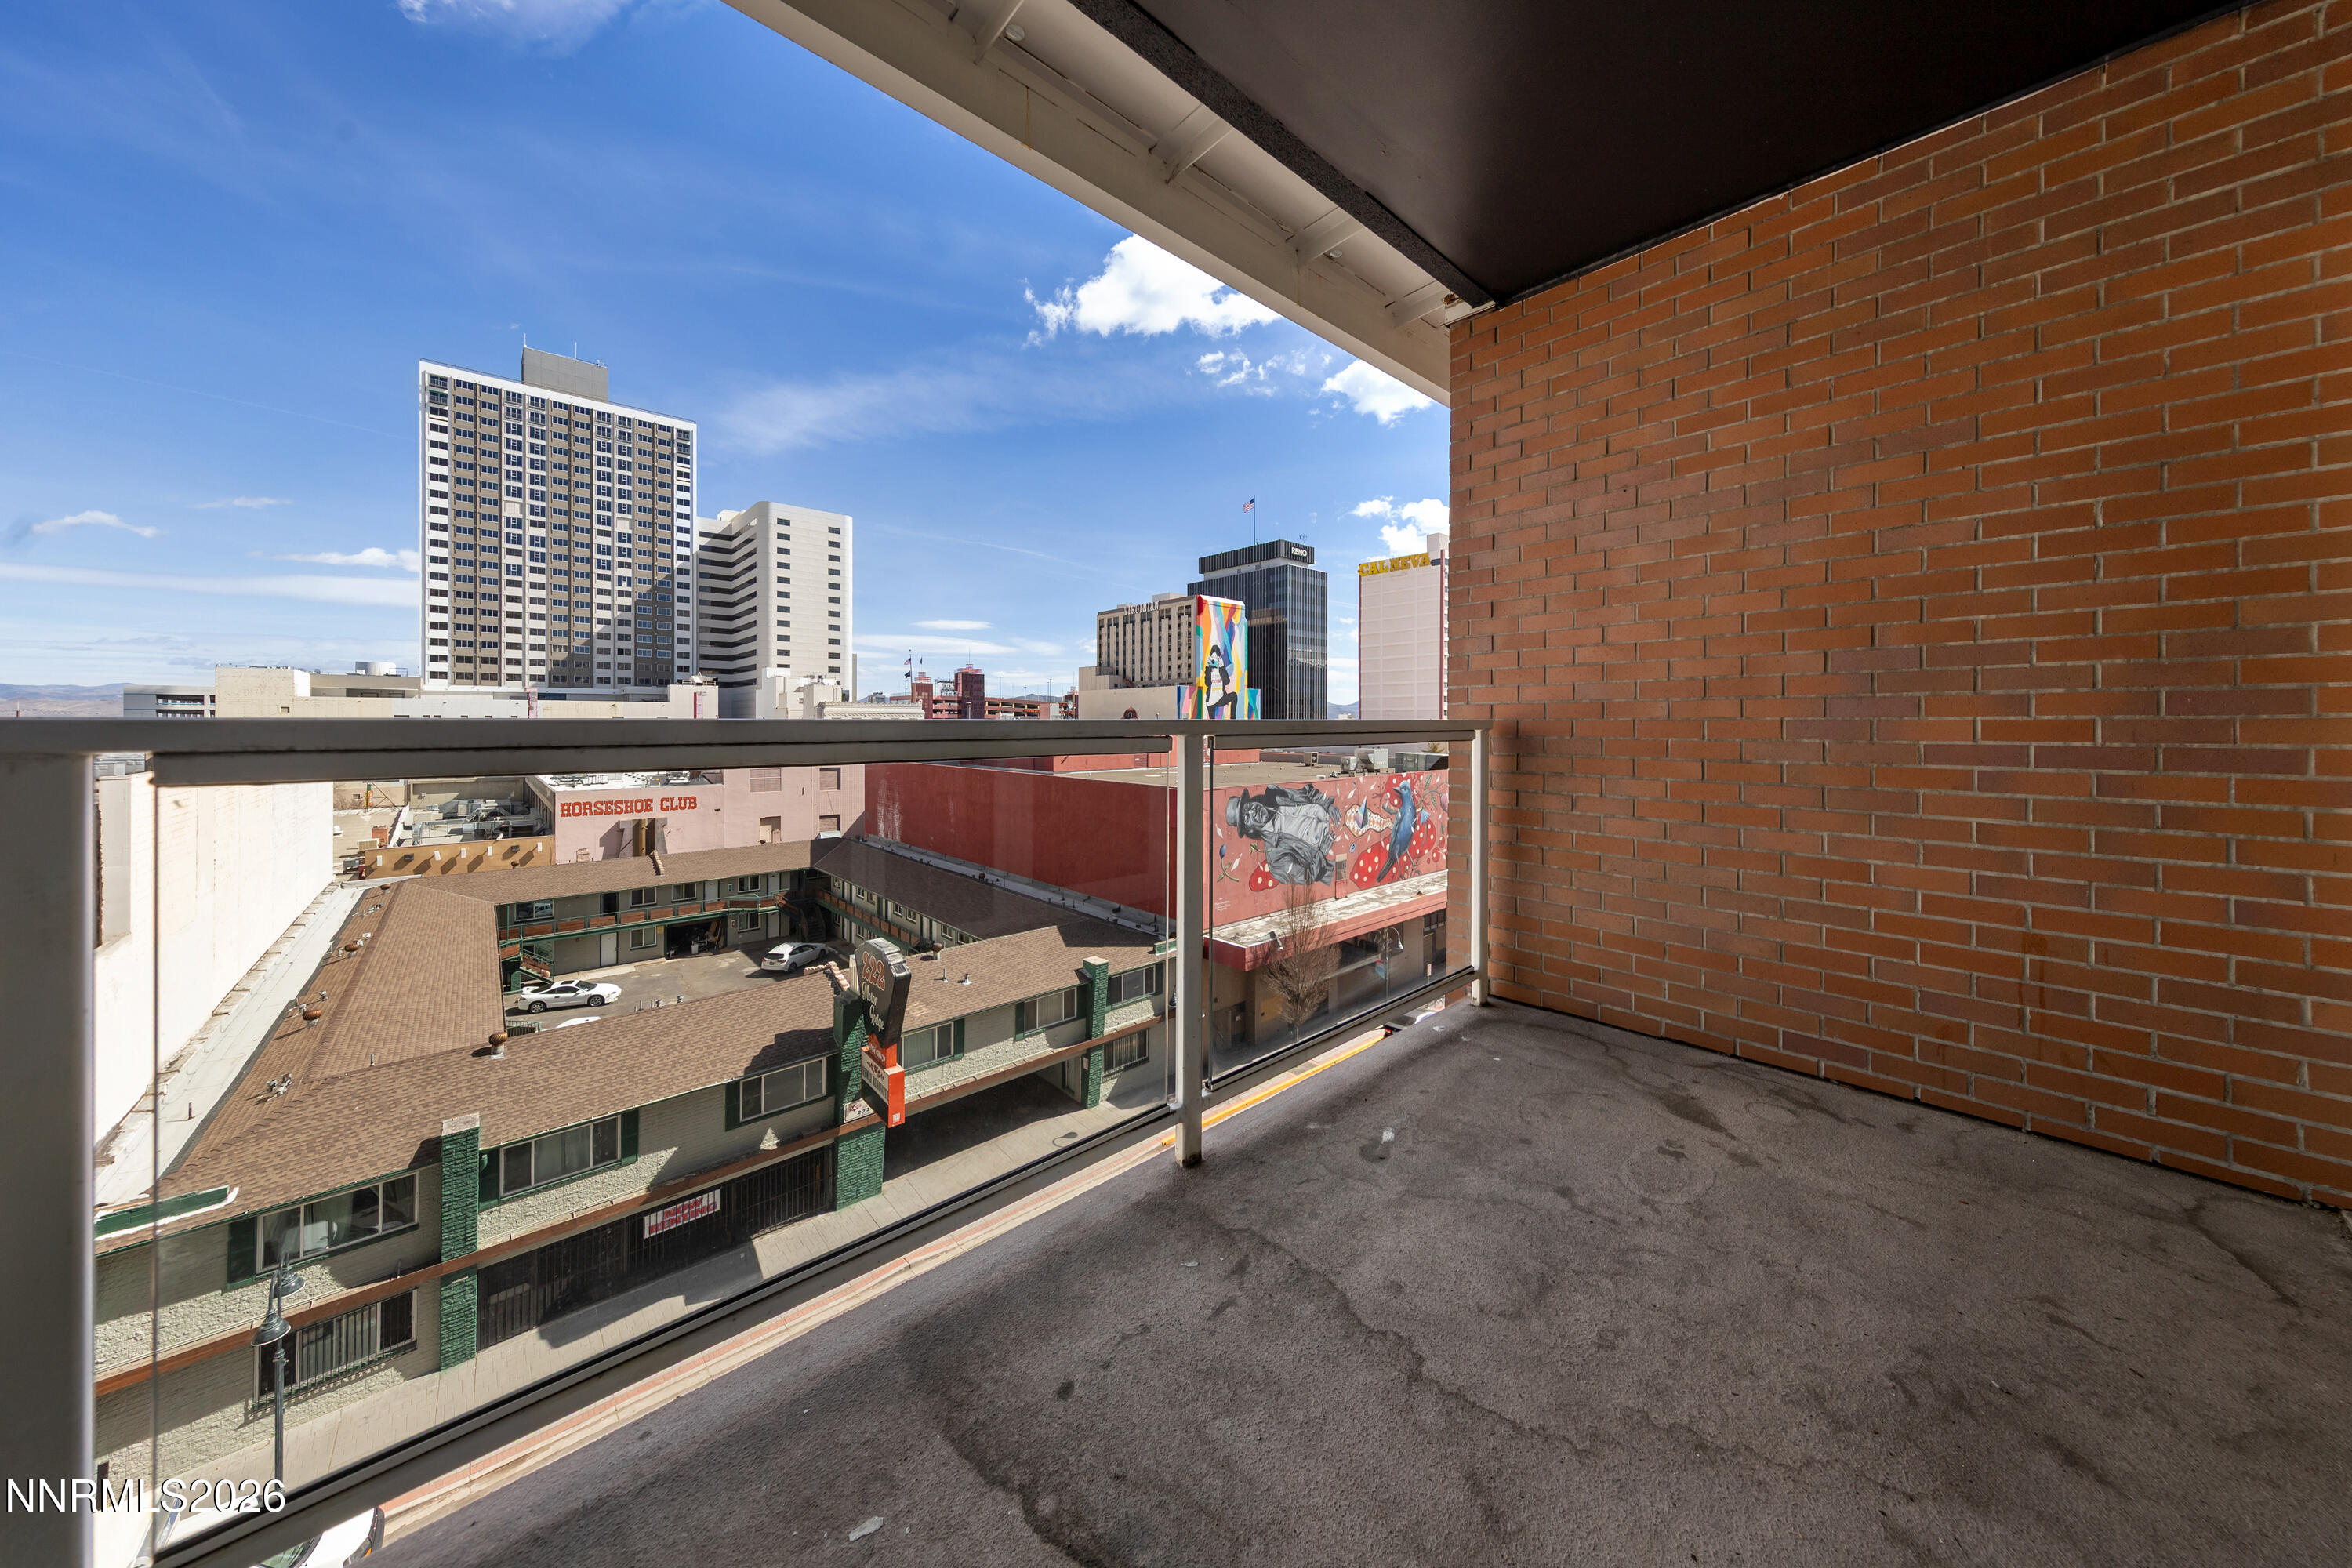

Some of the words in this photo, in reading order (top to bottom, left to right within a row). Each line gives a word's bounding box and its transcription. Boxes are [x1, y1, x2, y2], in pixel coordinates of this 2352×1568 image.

[1291, 546, 1308, 557] RENO
[1358, 561, 1388, 577] CAL
[1389, 552, 1431, 572] NEVA
[1123, 601, 1160, 615] VIRGINIAN
[560, 798, 653, 818] HORSESHOE
[660, 796, 698, 811] CLUB
[862, 950, 885, 991] 222
[861, 982, 878, 1006] Motor
[869, 1004, 884, 1032] Lodge
[649, 1201, 717, 1234] RENTING
[664, 1197, 703, 1219] NOW
